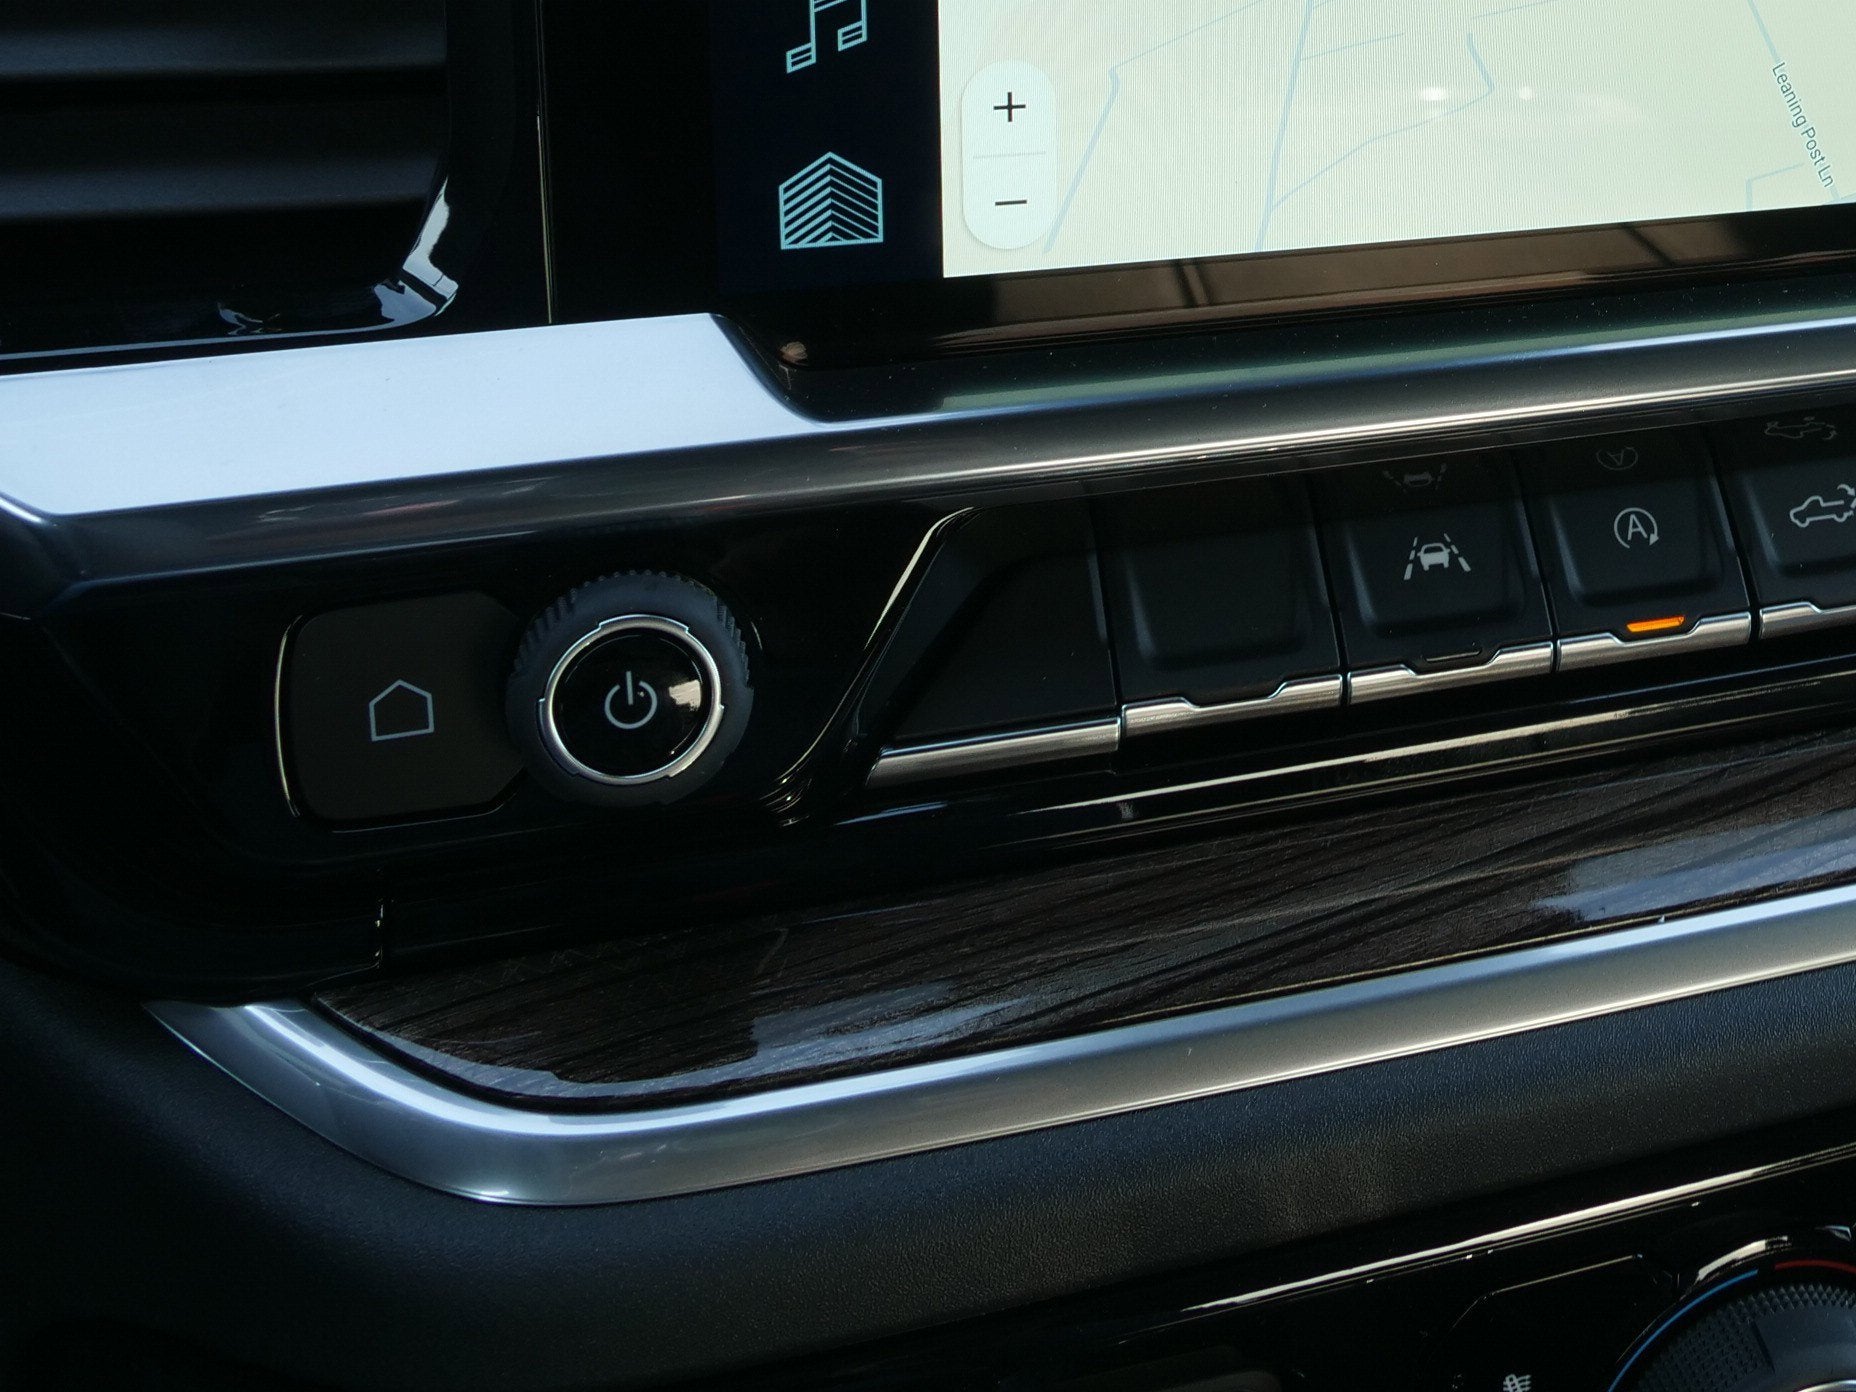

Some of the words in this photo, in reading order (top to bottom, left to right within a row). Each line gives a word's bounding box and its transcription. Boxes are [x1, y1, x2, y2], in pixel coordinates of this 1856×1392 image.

[1772, 61, 1807, 128] Leaning
[1800, 126, 1826, 167] Post
[1817, 164, 1834, 188] Ln
[1627, 513, 1649, 541] A
